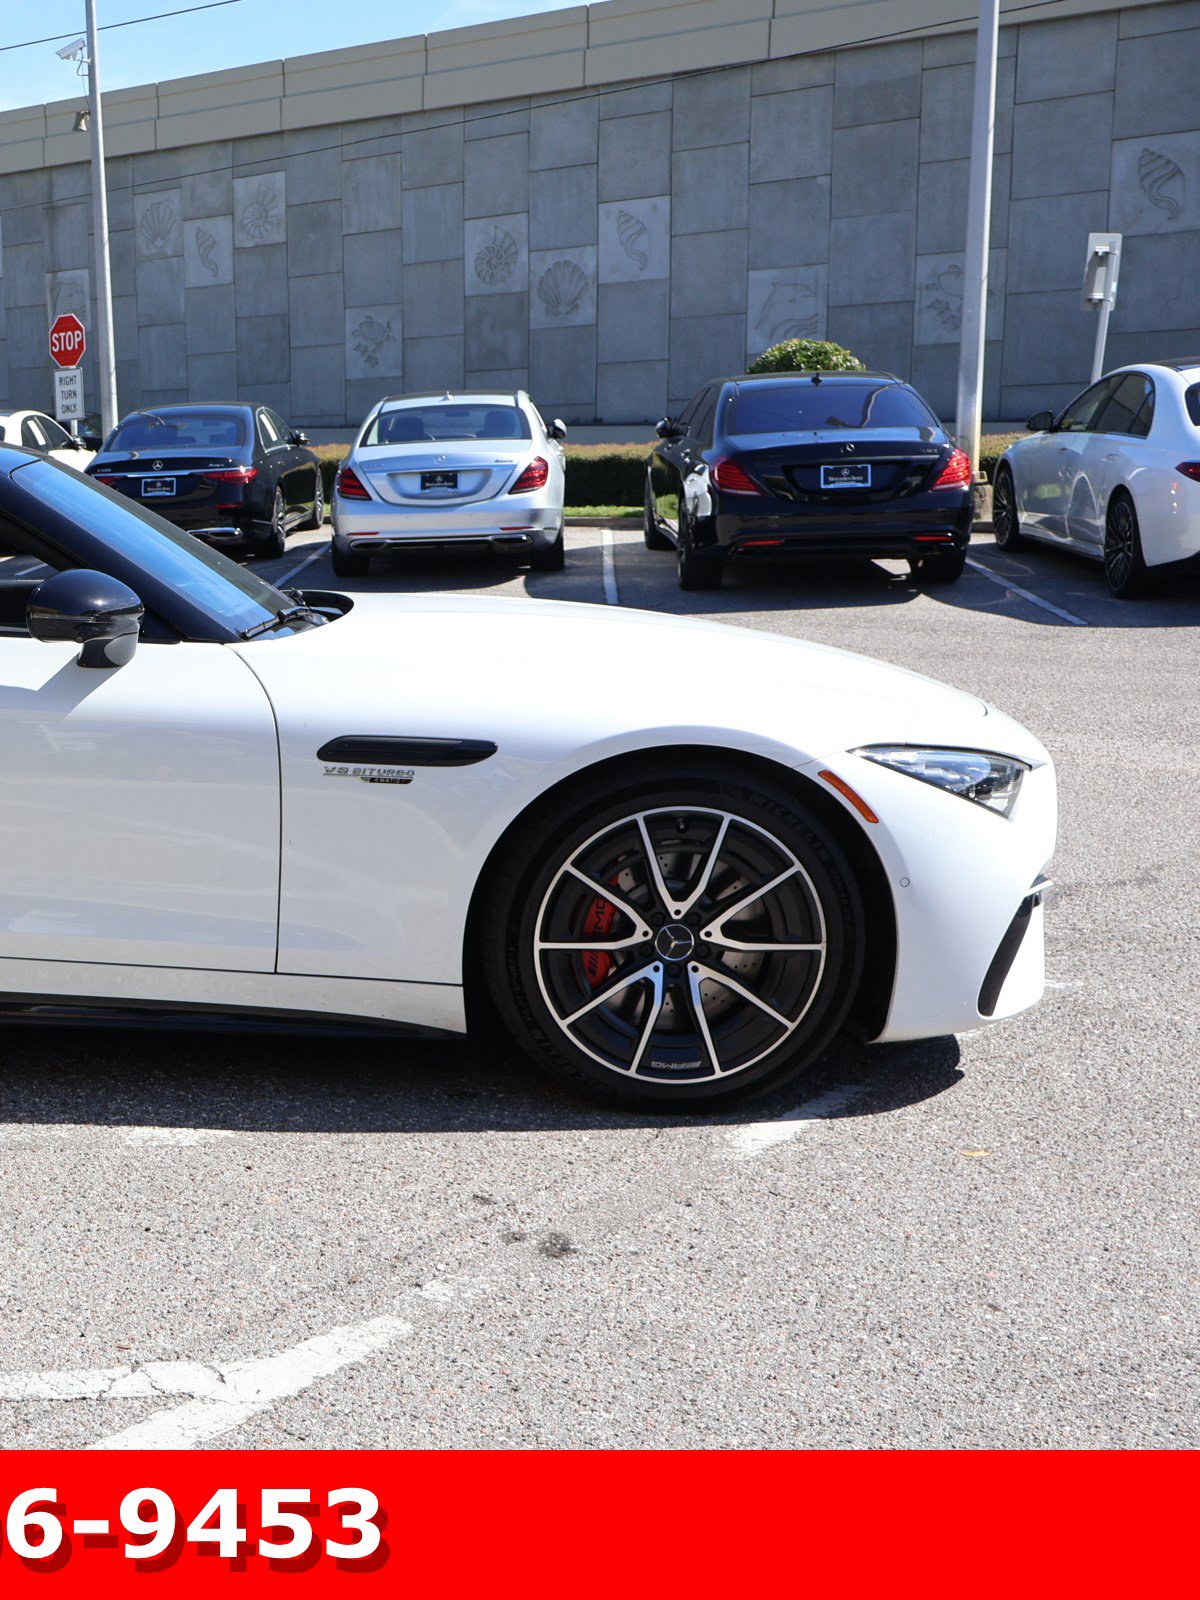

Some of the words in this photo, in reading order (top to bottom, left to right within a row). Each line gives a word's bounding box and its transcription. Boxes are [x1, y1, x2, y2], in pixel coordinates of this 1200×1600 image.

[51, 330, 83, 352] STOP
[59, 375, 76, 387] RIGHT
[61, 389, 77, 401] TURN
[61, 403, 77, 415] ONLY
[323, 766, 349, 774] V8
[352, 767, 415, 777] BITURBO
